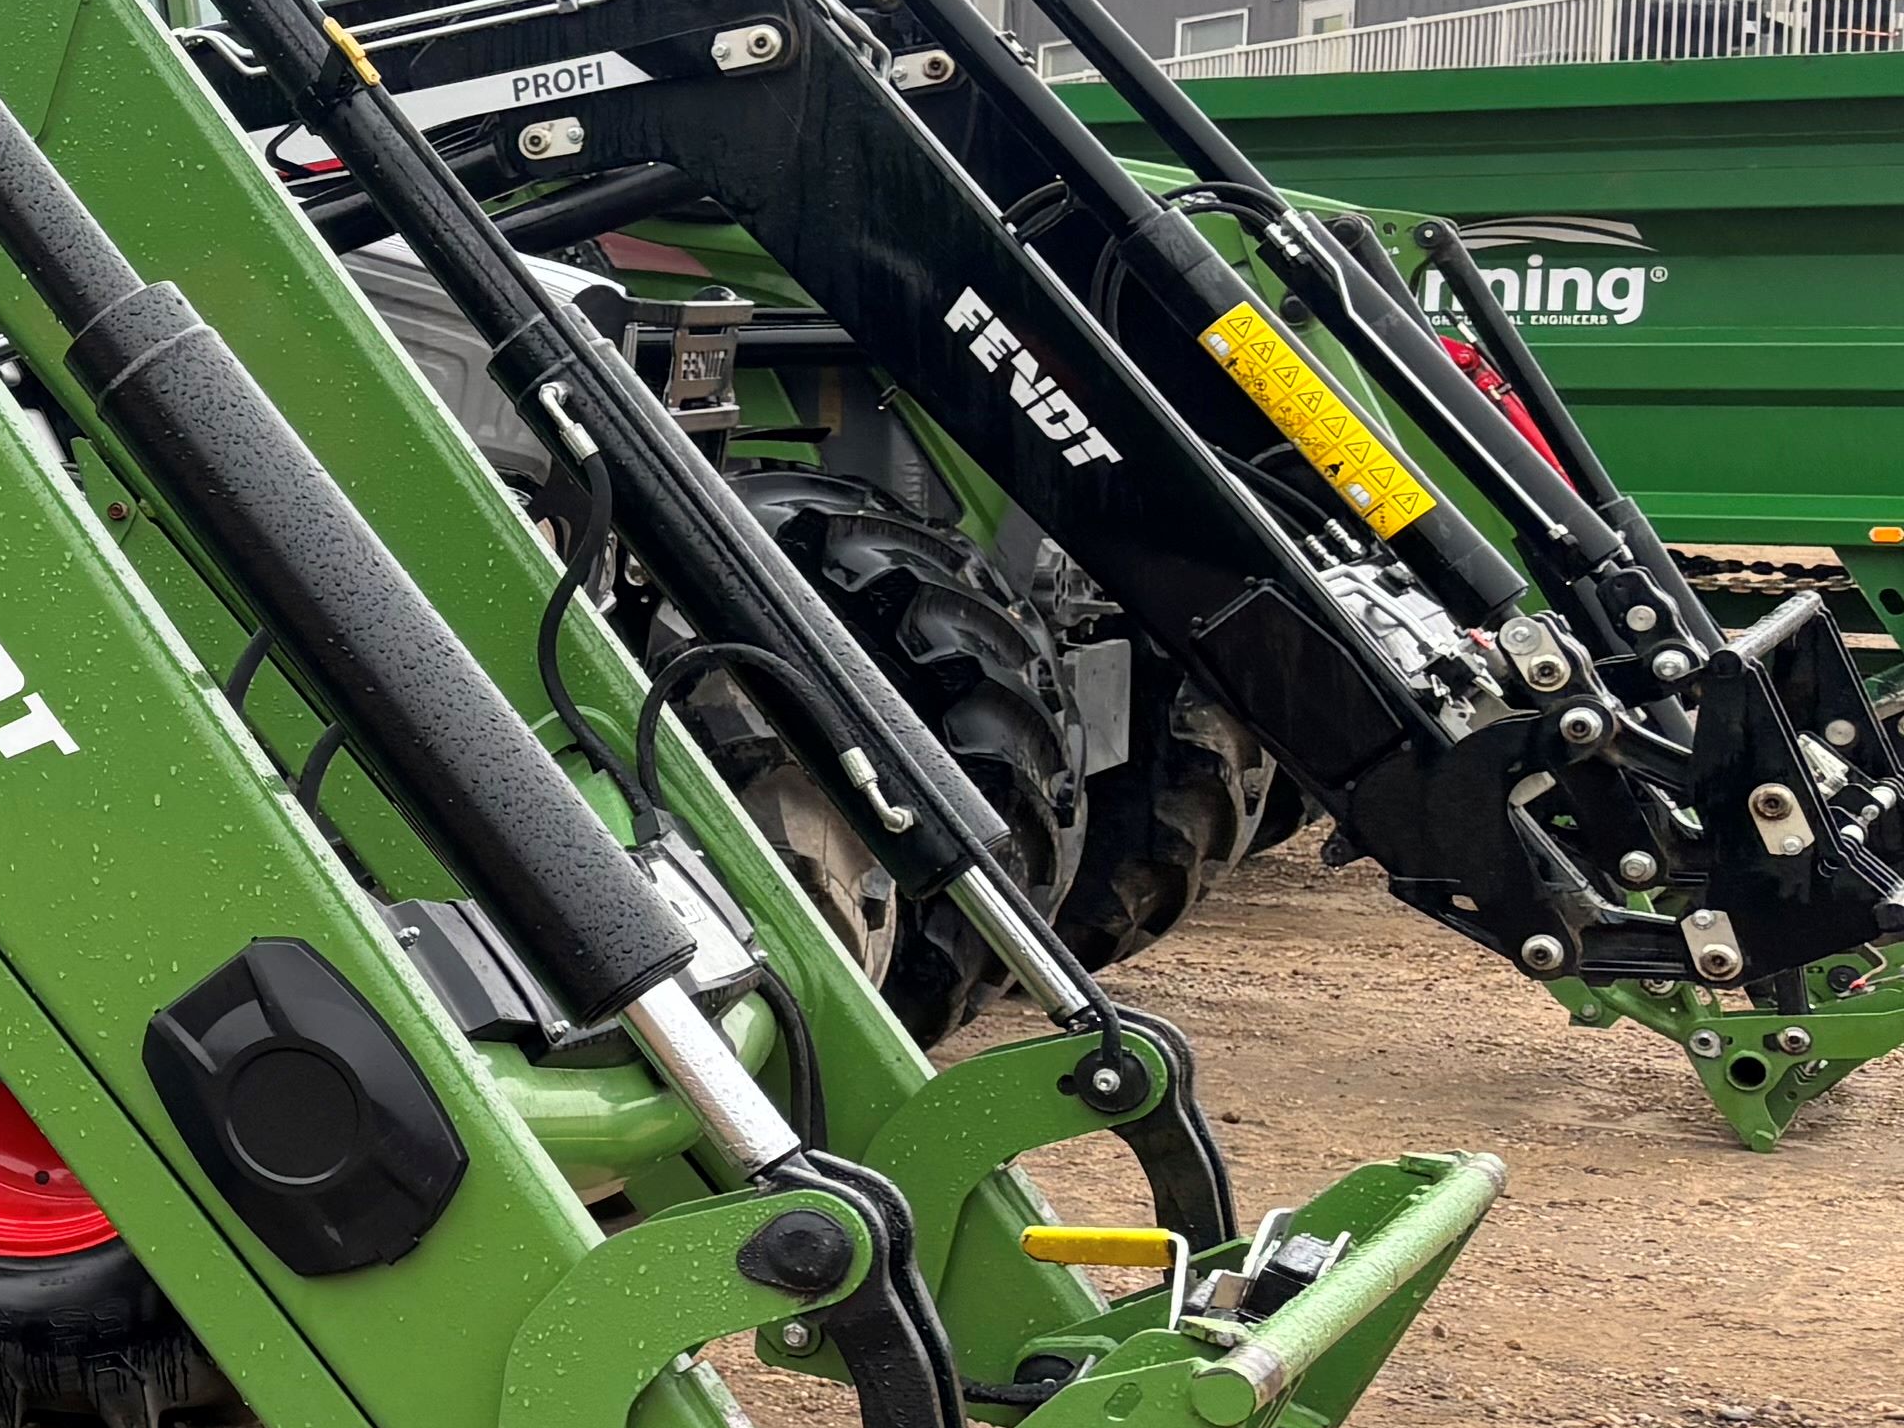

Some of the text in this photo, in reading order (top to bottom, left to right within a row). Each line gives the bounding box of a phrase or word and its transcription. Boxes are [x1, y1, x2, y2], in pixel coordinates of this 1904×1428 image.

[511, 60, 606, 105] PROFI
[1529, 314, 1608, 326] ENGINEERS
[943, 286, 1123, 468] FENDT
